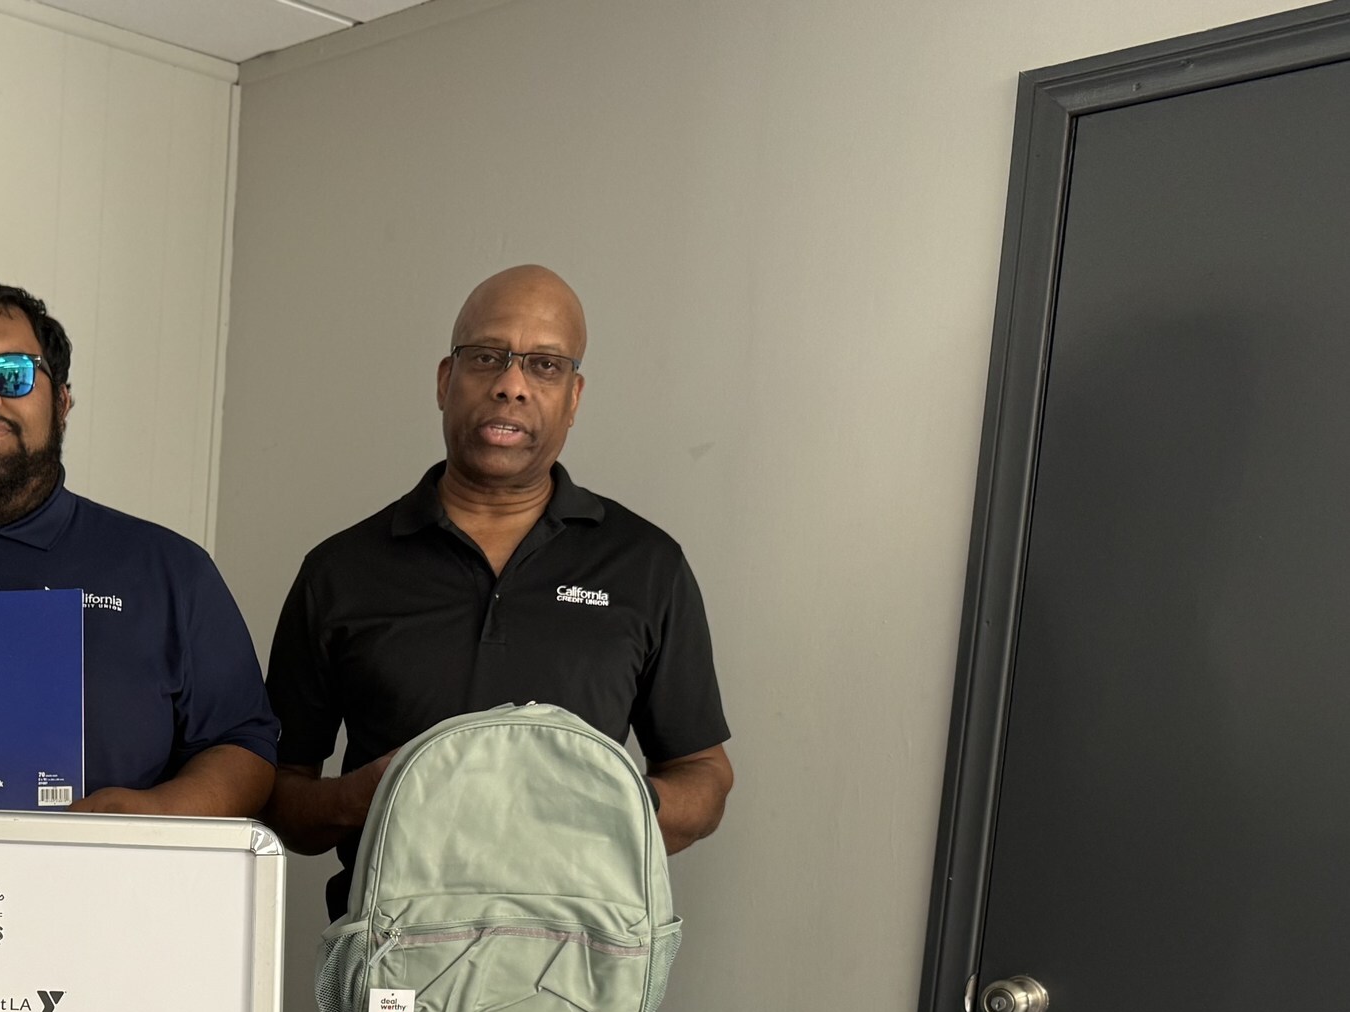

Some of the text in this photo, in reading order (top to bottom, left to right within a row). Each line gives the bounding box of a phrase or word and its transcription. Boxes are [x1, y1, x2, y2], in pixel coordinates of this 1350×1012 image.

[557, 586, 608, 600] California
[83, 594, 122, 607] ifornia
[98, 604, 122, 612] UNION
[10, 998, 31, 1011] LA
